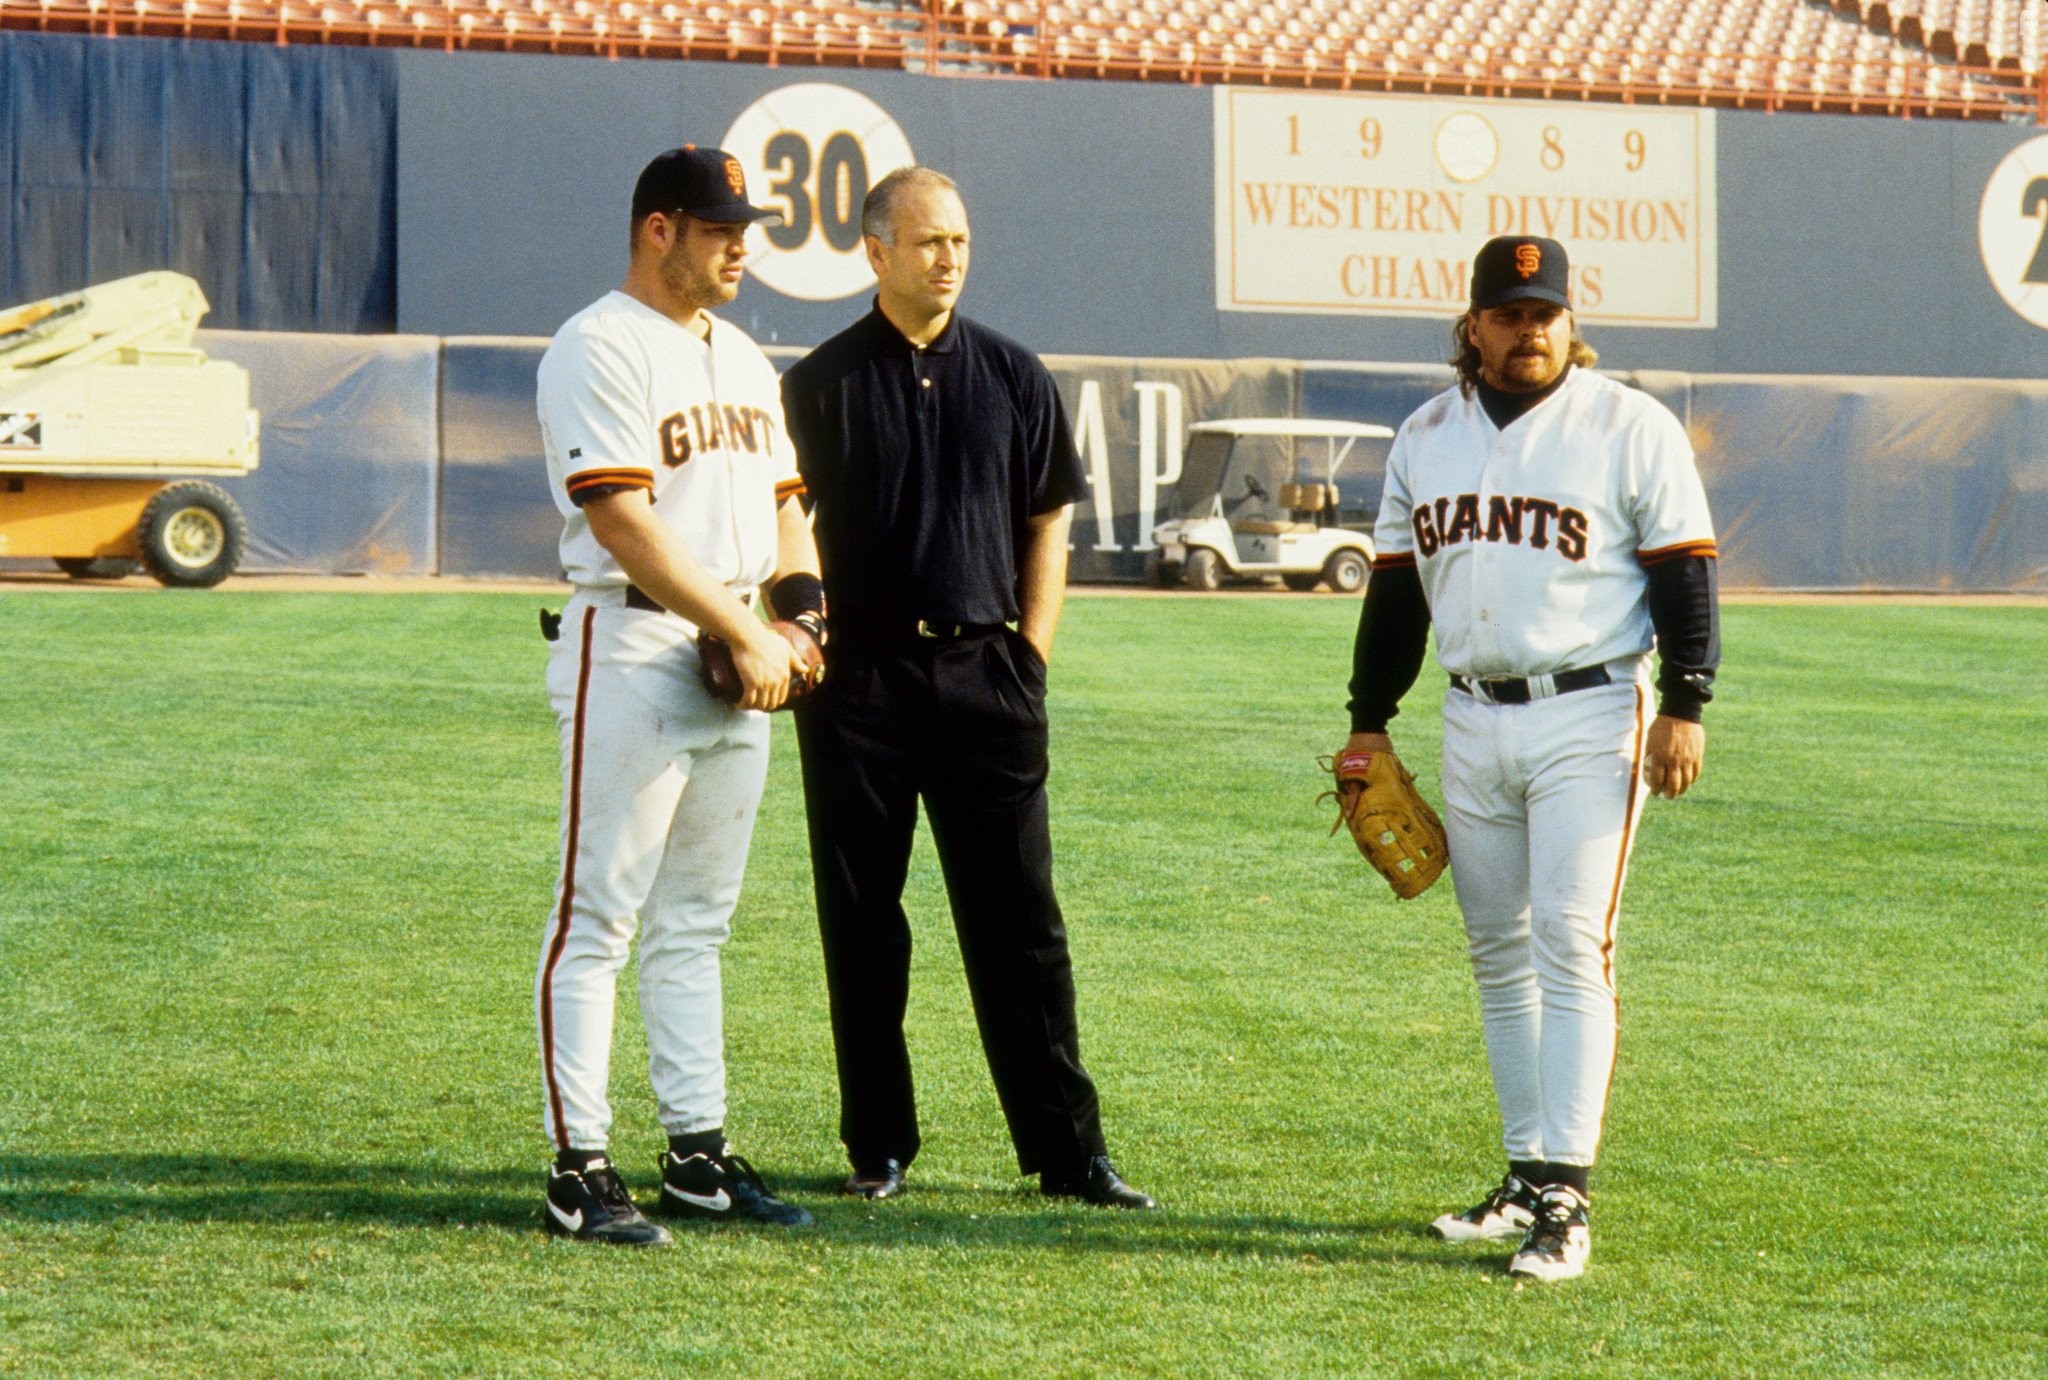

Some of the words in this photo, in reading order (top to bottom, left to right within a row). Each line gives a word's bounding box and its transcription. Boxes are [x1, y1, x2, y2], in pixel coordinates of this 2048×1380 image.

[764, 130, 869, 252] 30
[1243, 181, 1465, 234] WESTERN
[1487, 194, 1688, 242] DIVISION
[1412, 494, 1588, 563] GIANTS
